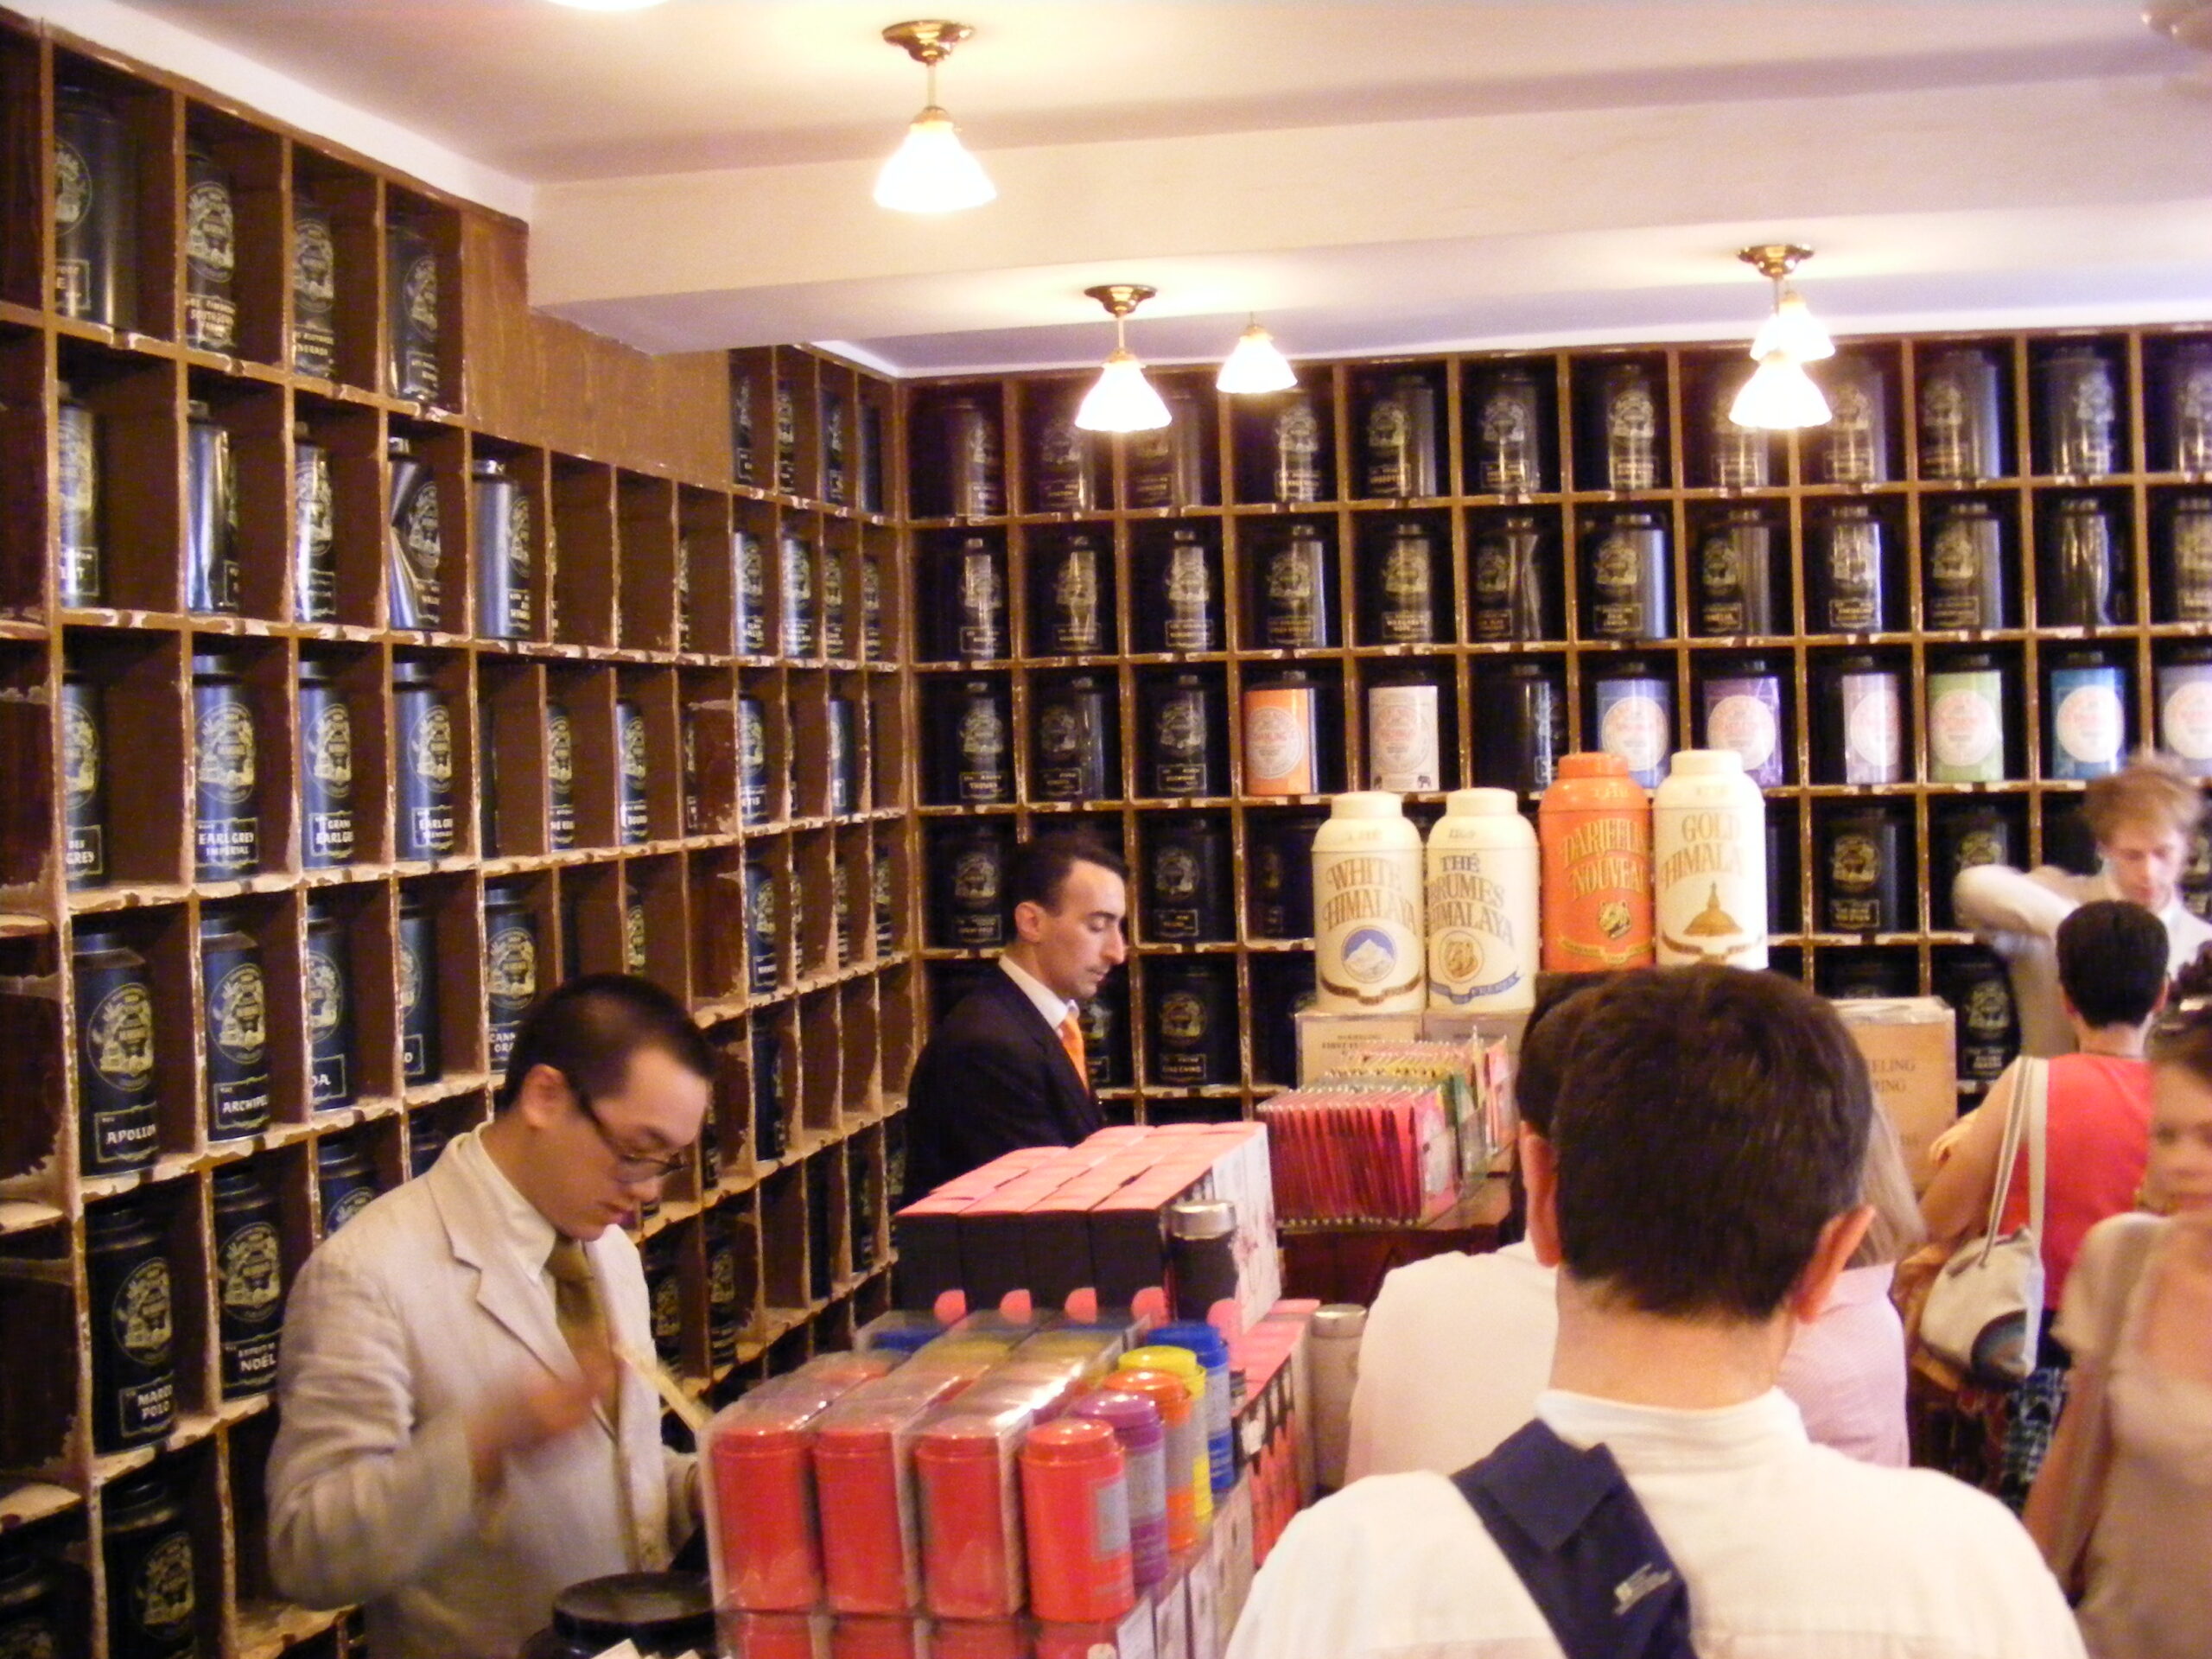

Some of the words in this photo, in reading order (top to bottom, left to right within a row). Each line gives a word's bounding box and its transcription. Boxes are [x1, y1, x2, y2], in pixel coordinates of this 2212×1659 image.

[198, 832, 230, 845] EARL
[1681, 811, 1740, 842] GOLD
[1325, 856, 1402, 891] WHITE
[1440, 852, 1480, 874] THÉ
[1323, 888, 1417, 935] HIMALAYA
[1428, 900, 1516, 950] IMALAYA
